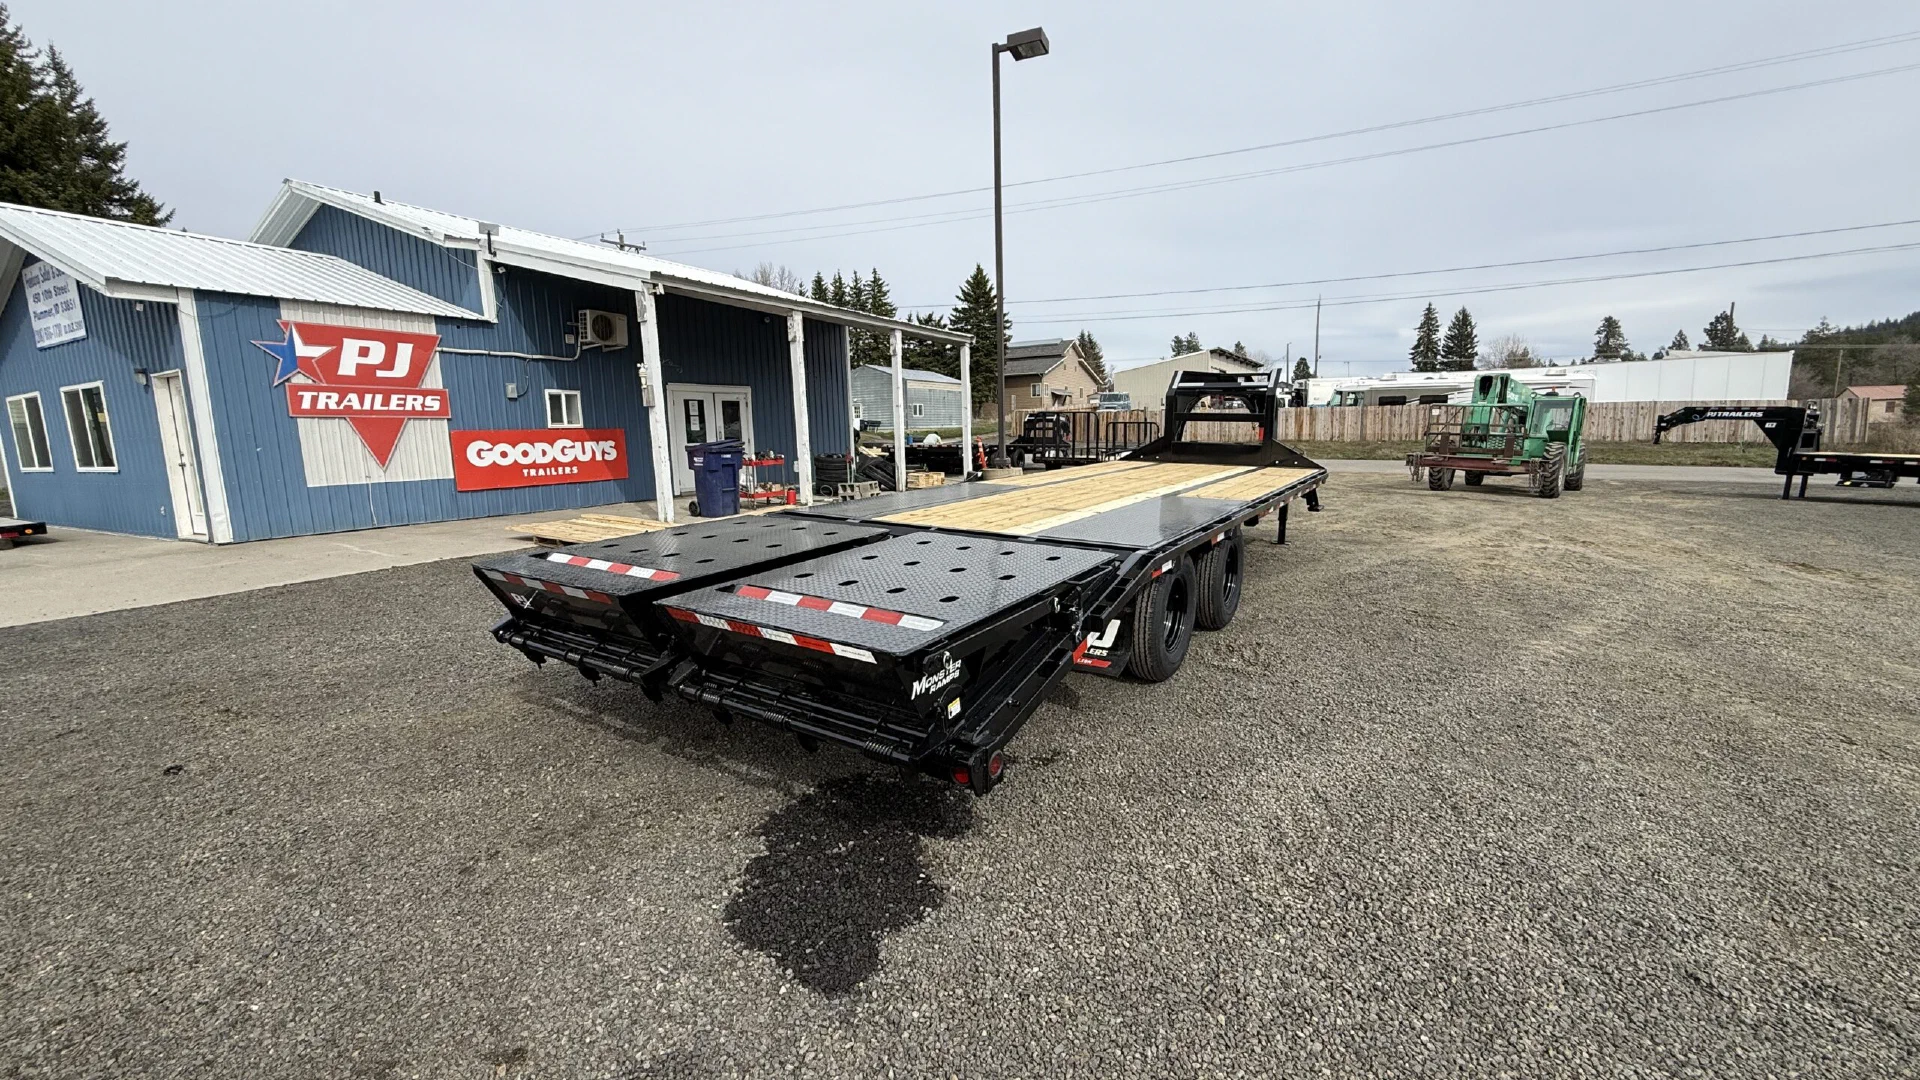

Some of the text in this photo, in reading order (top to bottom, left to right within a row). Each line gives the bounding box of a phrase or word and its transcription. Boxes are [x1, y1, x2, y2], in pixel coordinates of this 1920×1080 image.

[337, 338, 414, 378] PJ
[297, 391, 441, 412] TRAILERS
[522, 466, 579, 477] TRAILERS
[929, 669, 960, 695] RAMPS
